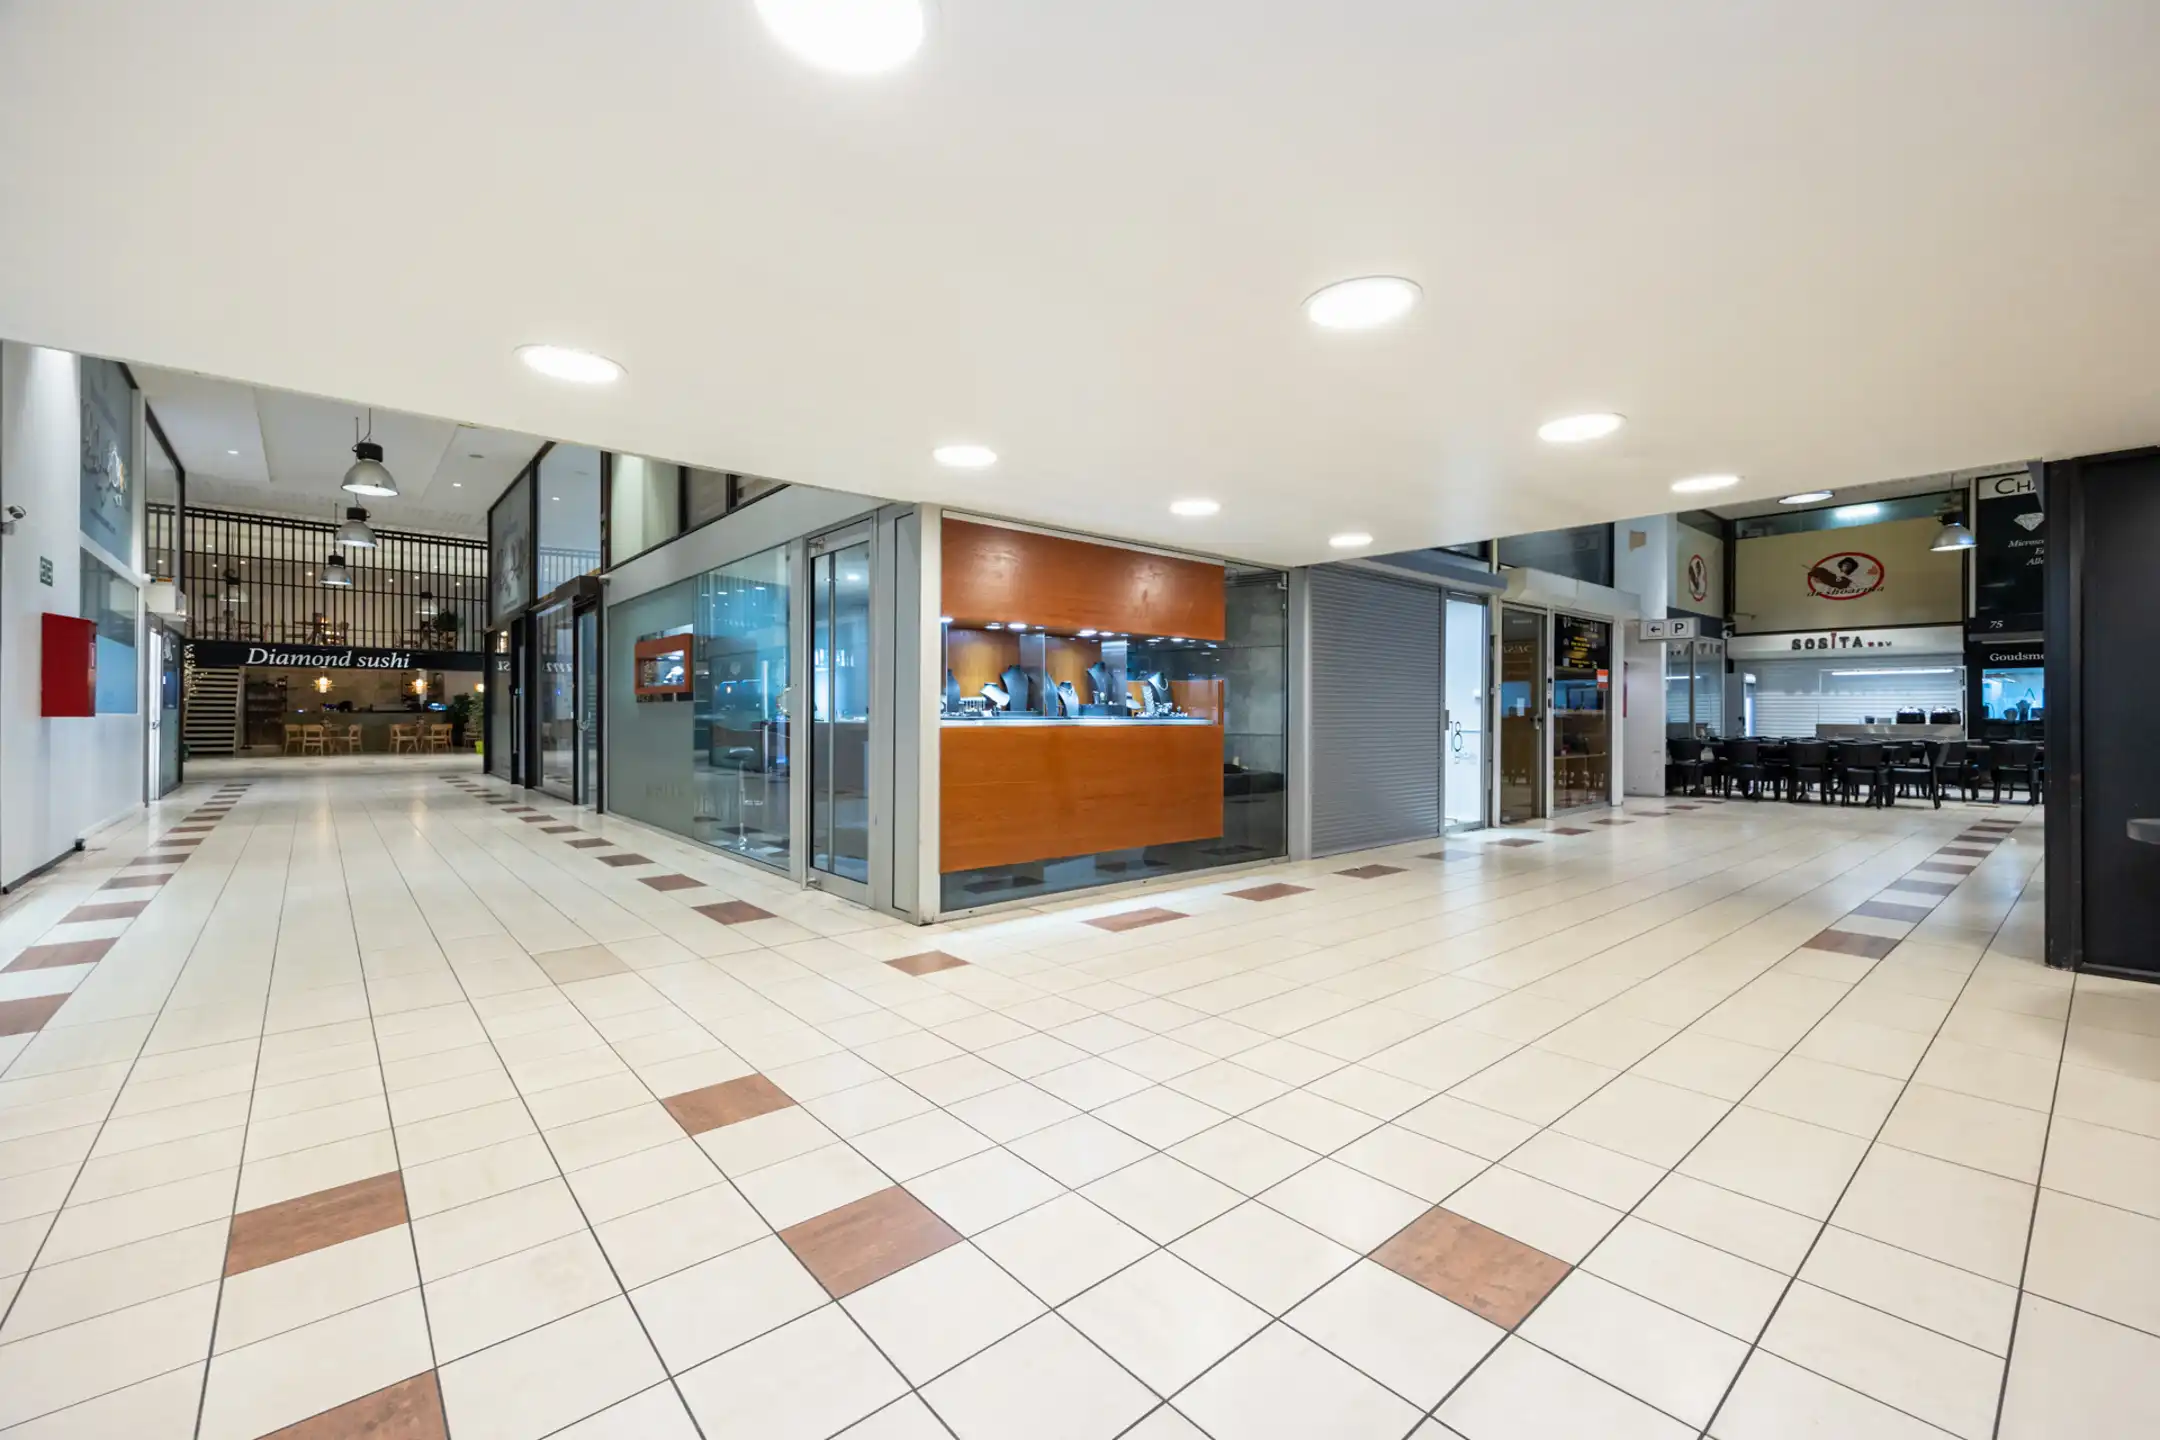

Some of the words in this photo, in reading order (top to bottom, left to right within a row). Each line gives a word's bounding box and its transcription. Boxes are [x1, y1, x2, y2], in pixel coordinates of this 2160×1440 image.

[1994, 477, 2036, 495] CH
[1674, 622, 1685, 634] P
[1989, 620, 2004, 630] 75
[1791, 631, 1864, 651] SOSITA
[246, 647, 352, 668] Diamond
[356, 652, 411, 669] sushi
